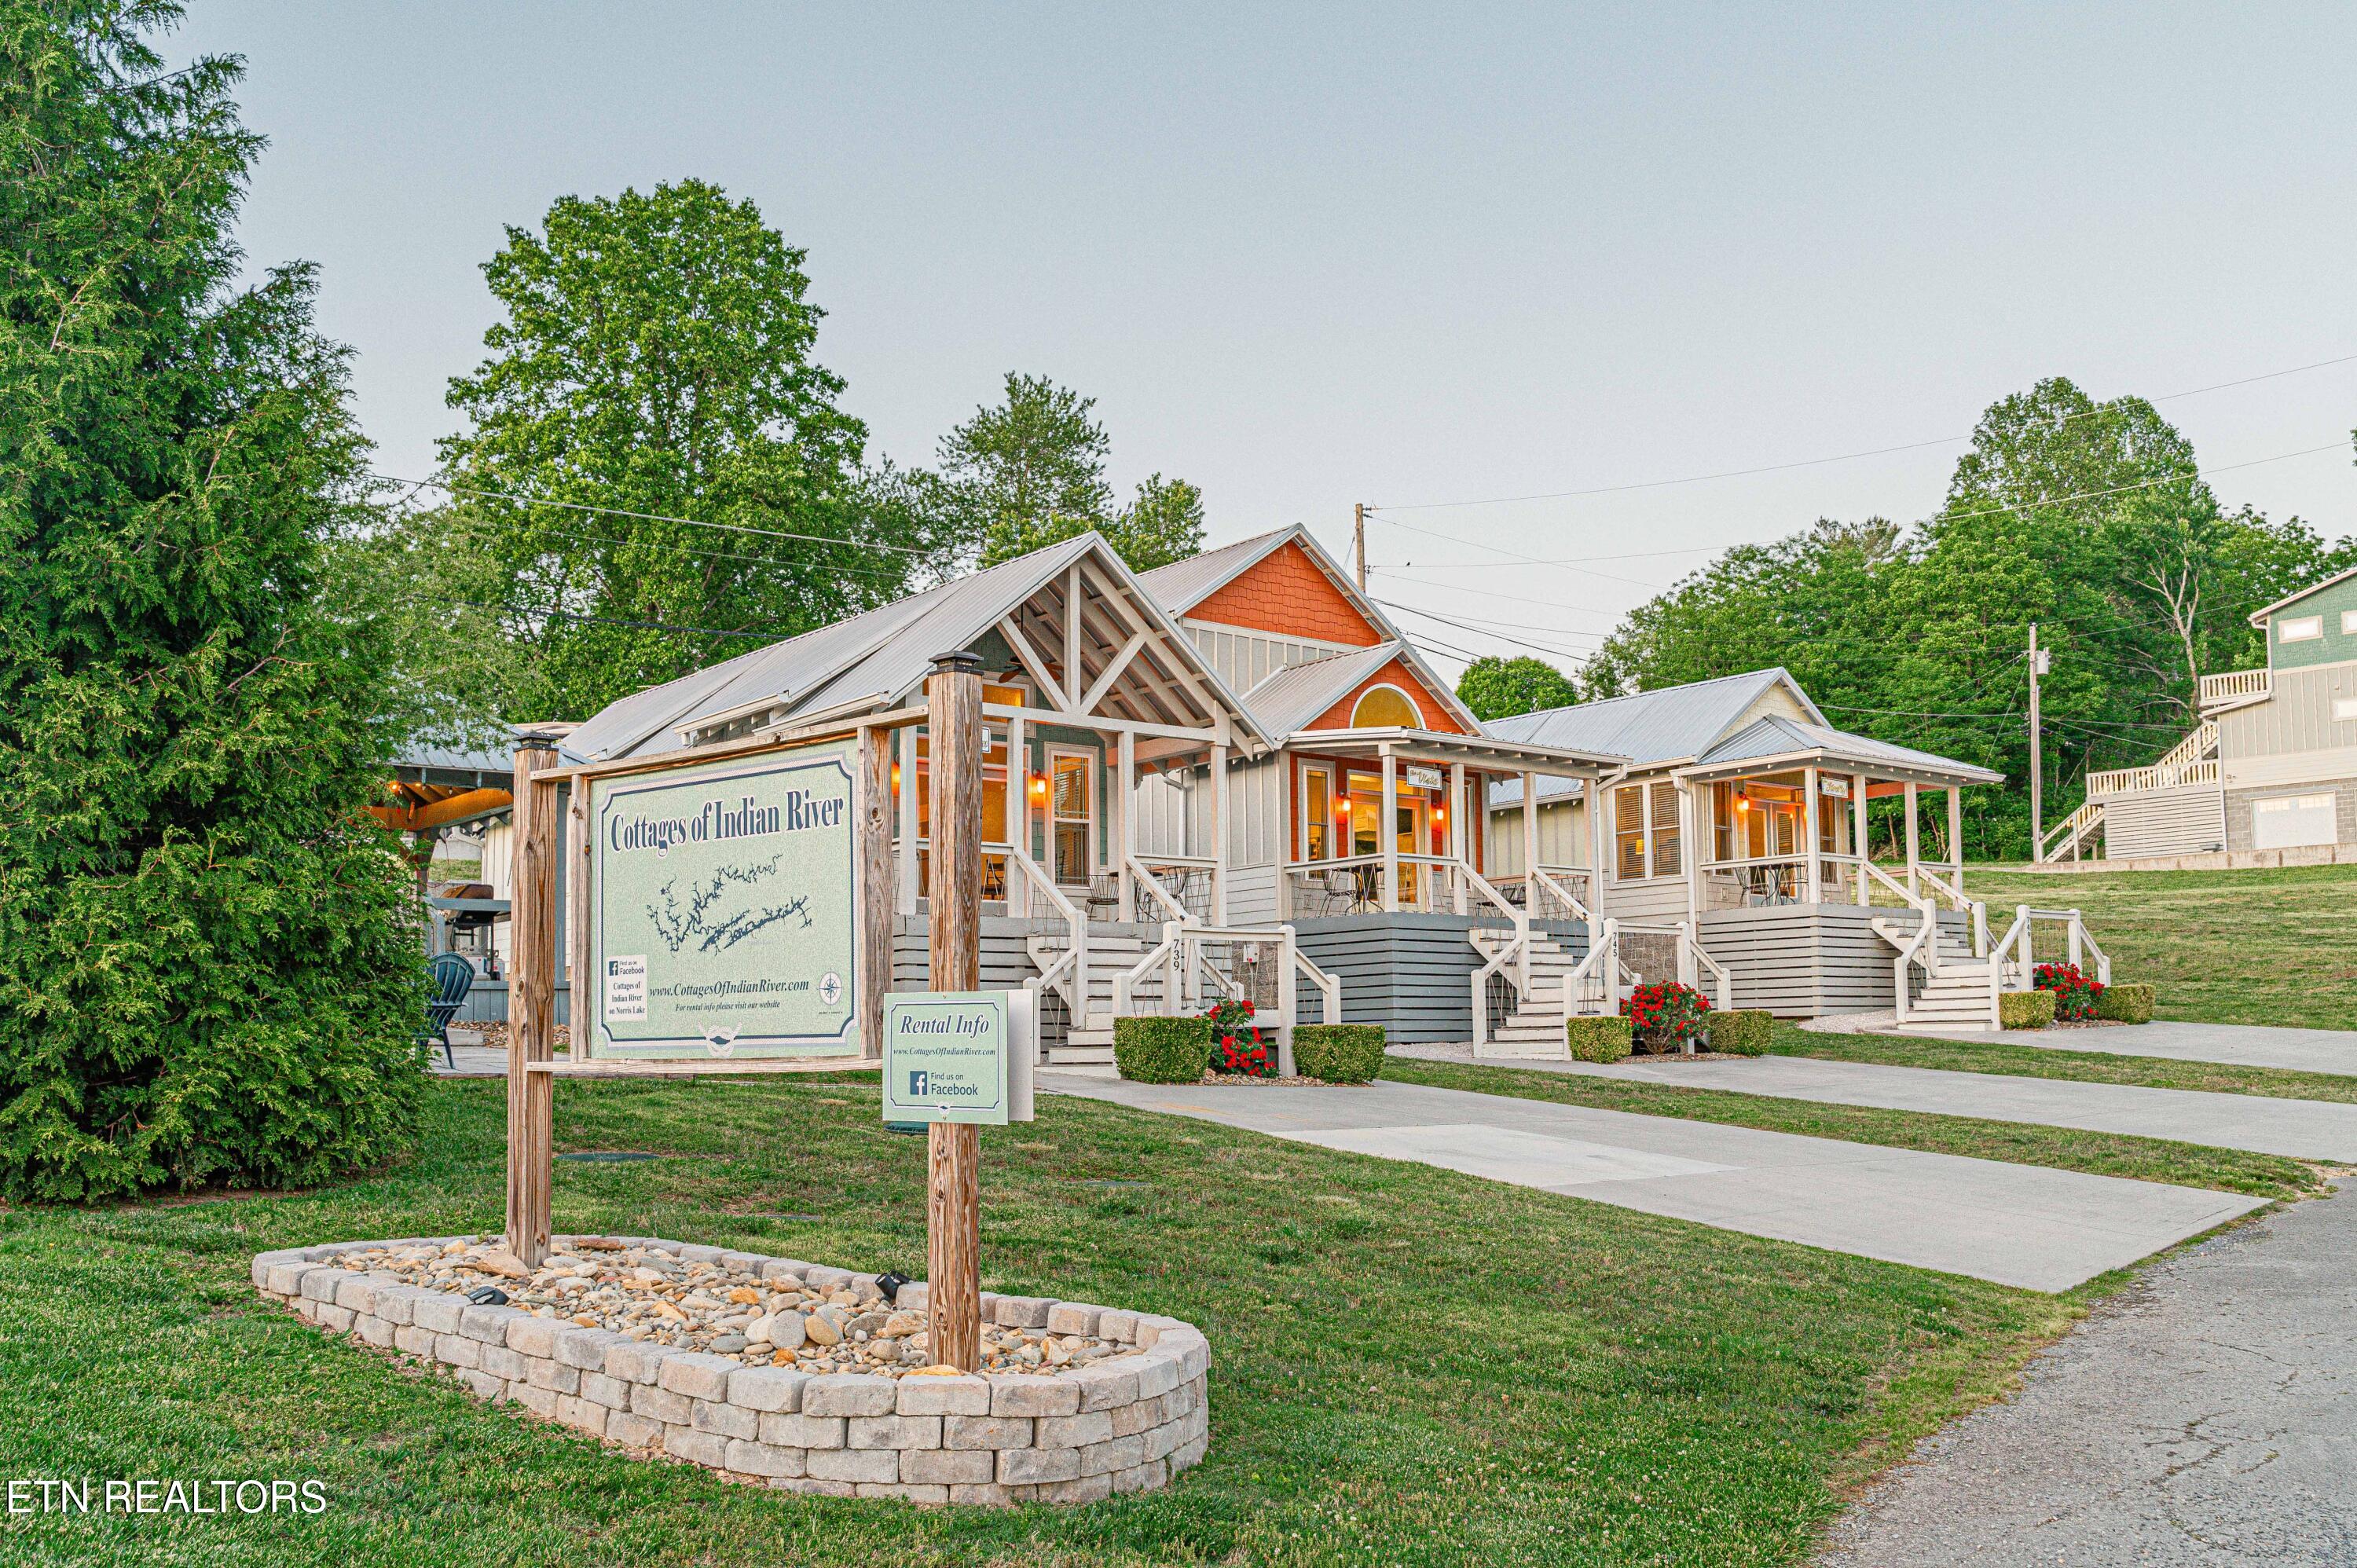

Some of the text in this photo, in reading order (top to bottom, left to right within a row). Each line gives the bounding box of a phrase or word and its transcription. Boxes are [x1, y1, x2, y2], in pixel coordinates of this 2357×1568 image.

[610, 789, 845, 857] Cottages of Indian River
[620, 966, 645, 975] Facebook
[613, 982, 634, 992] Cottages
[650, 979, 809, 998] www.CottagesOfIndianRiver.com
[632, 1006, 645, 1014] Lake
[704, 1002, 715, 1012] info
[716, 1002, 734, 1012] please
[735, 1001, 746, 1009] visit
[759, 999, 780, 1009] website
[900, 1013, 990, 1039] Rental Info
[893, 1046, 995, 1057] www.CottagesOfIndianRiver.com
[931, 1083, 978, 1096] Facebook
